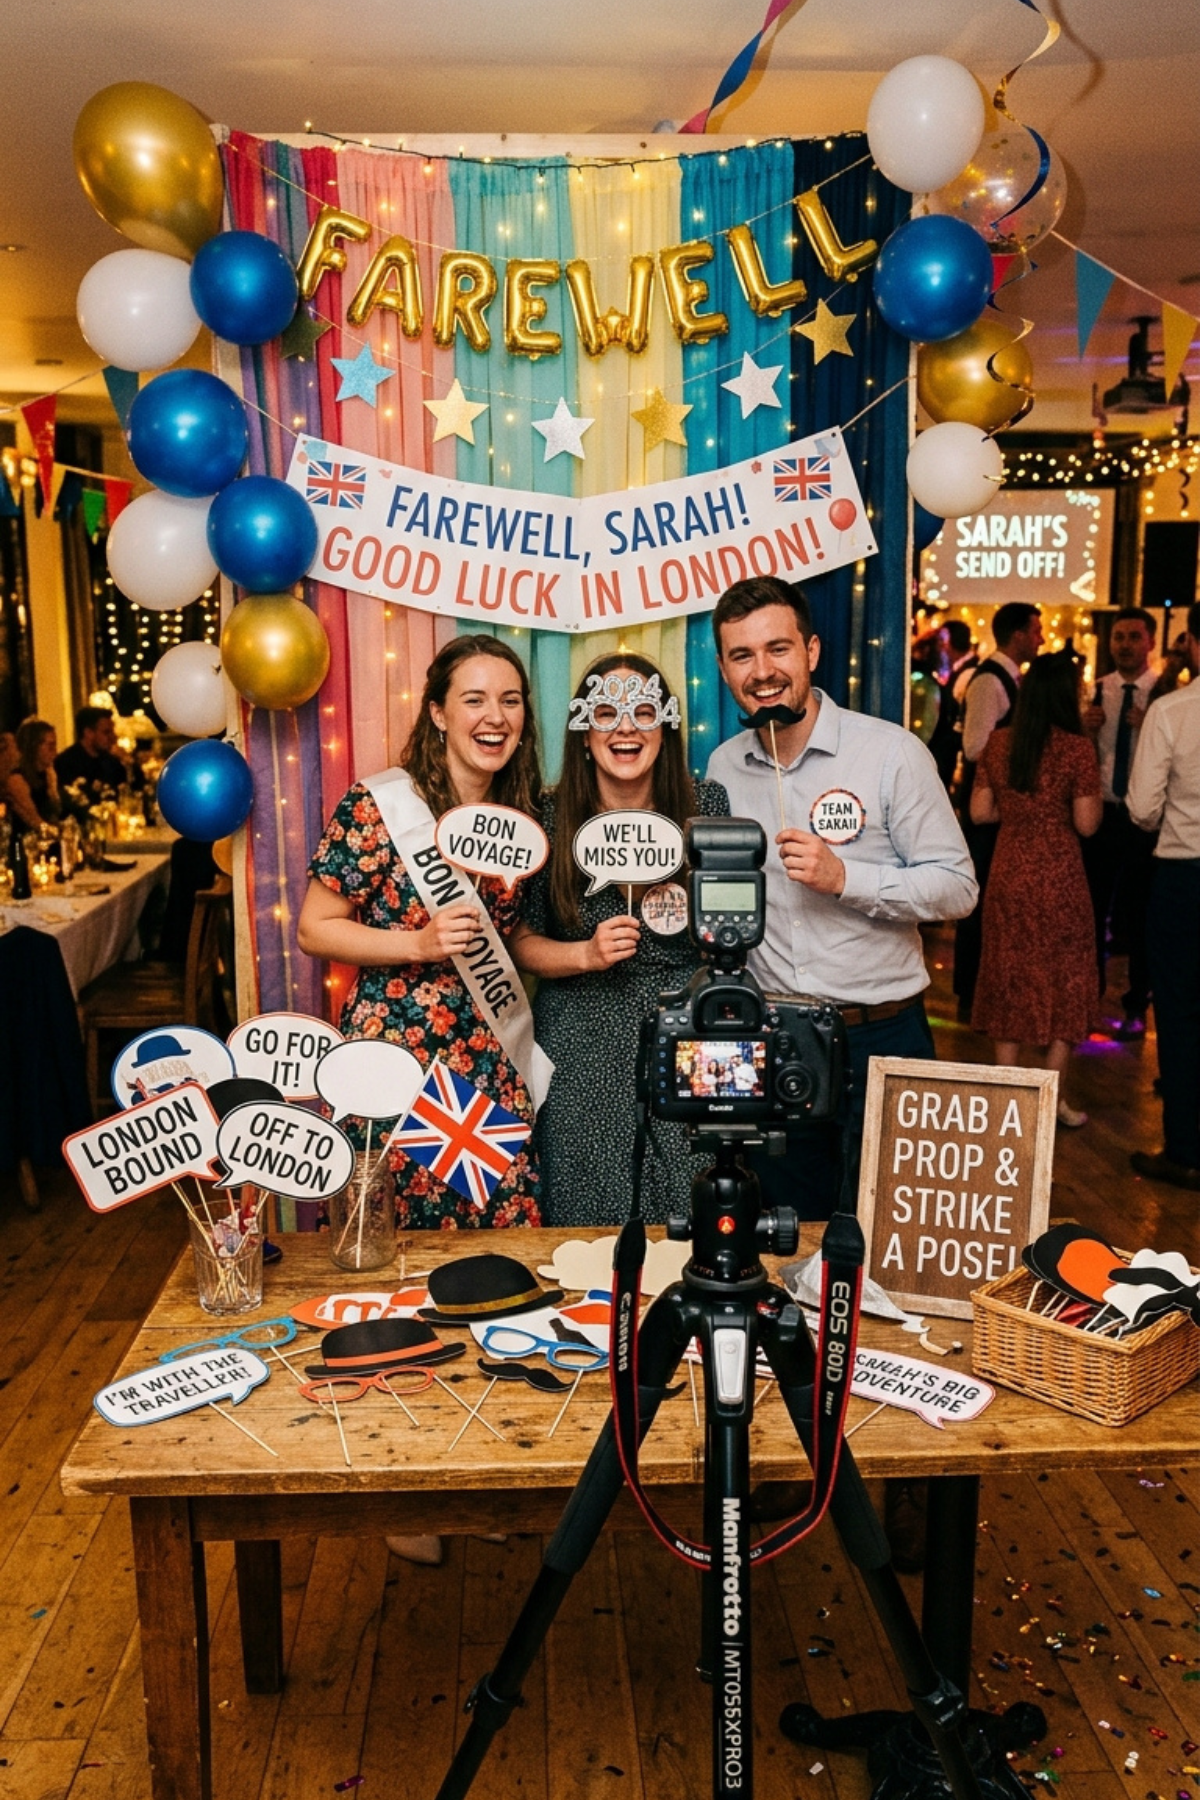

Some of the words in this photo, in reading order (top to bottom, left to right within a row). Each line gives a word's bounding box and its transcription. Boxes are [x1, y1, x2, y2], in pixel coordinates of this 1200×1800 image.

[299, 186, 878, 360] FAREWELL
[385, 484, 592, 568] FAREWELL,
[604, 481, 751, 557] SARAH!
[955, 514, 1068, 548] SARAH'S
[322, 525, 441, 597] GOOD
[454, 558, 558, 618] LUCK
[580, 568, 622, 620] IN
[637, 516, 825, 610] LONDON!
[955, 551, 1011, 578] SEND
[1017, 551, 1066, 578] OFF!
[449, 833, 533, 870] VOYAGE!
[472, 813, 517, 841] BON
[603, 823, 657, 843] WE'LL
[584, 846, 628, 867] MISS
[633, 847, 676, 867] YOU!
[412, 843, 465, 908] BON
[460, 935, 518, 1020] OYAGE
[245, 1027, 279, 1055] GO
[286, 1031, 333, 1060] FOR
[271, 1060, 301, 1088] IT!
[80, 1095, 199, 1170] LONDON
[249, 1111, 300, 1147] OFF
[302, 1128, 335, 1162] TO
[897, 1089, 990, 1135] GRAB
[998, 1099, 1023, 1138] A
[103, 1130, 203, 1196] BOUND
[228, 1135, 333, 1193] LONDON
[892, 1137, 985, 1182] PROP
[994, 1147, 1020, 1187] &
[891, 1185, 1014, 1235] STRIKE
[881, 1232, 905, 1271] A
[829, 1280, 851, 1336] EOS
[104, 1386, 142, 1408] I'M
[142, 1366, 198, 1393] WITH
[200, 1352, 244, 1375] THE
[825, 1339, 846, 1384] 80D
[852, 1369, 967, 1415] DVENTURE
[722, 1497, 743, 1637] Manfrotto
